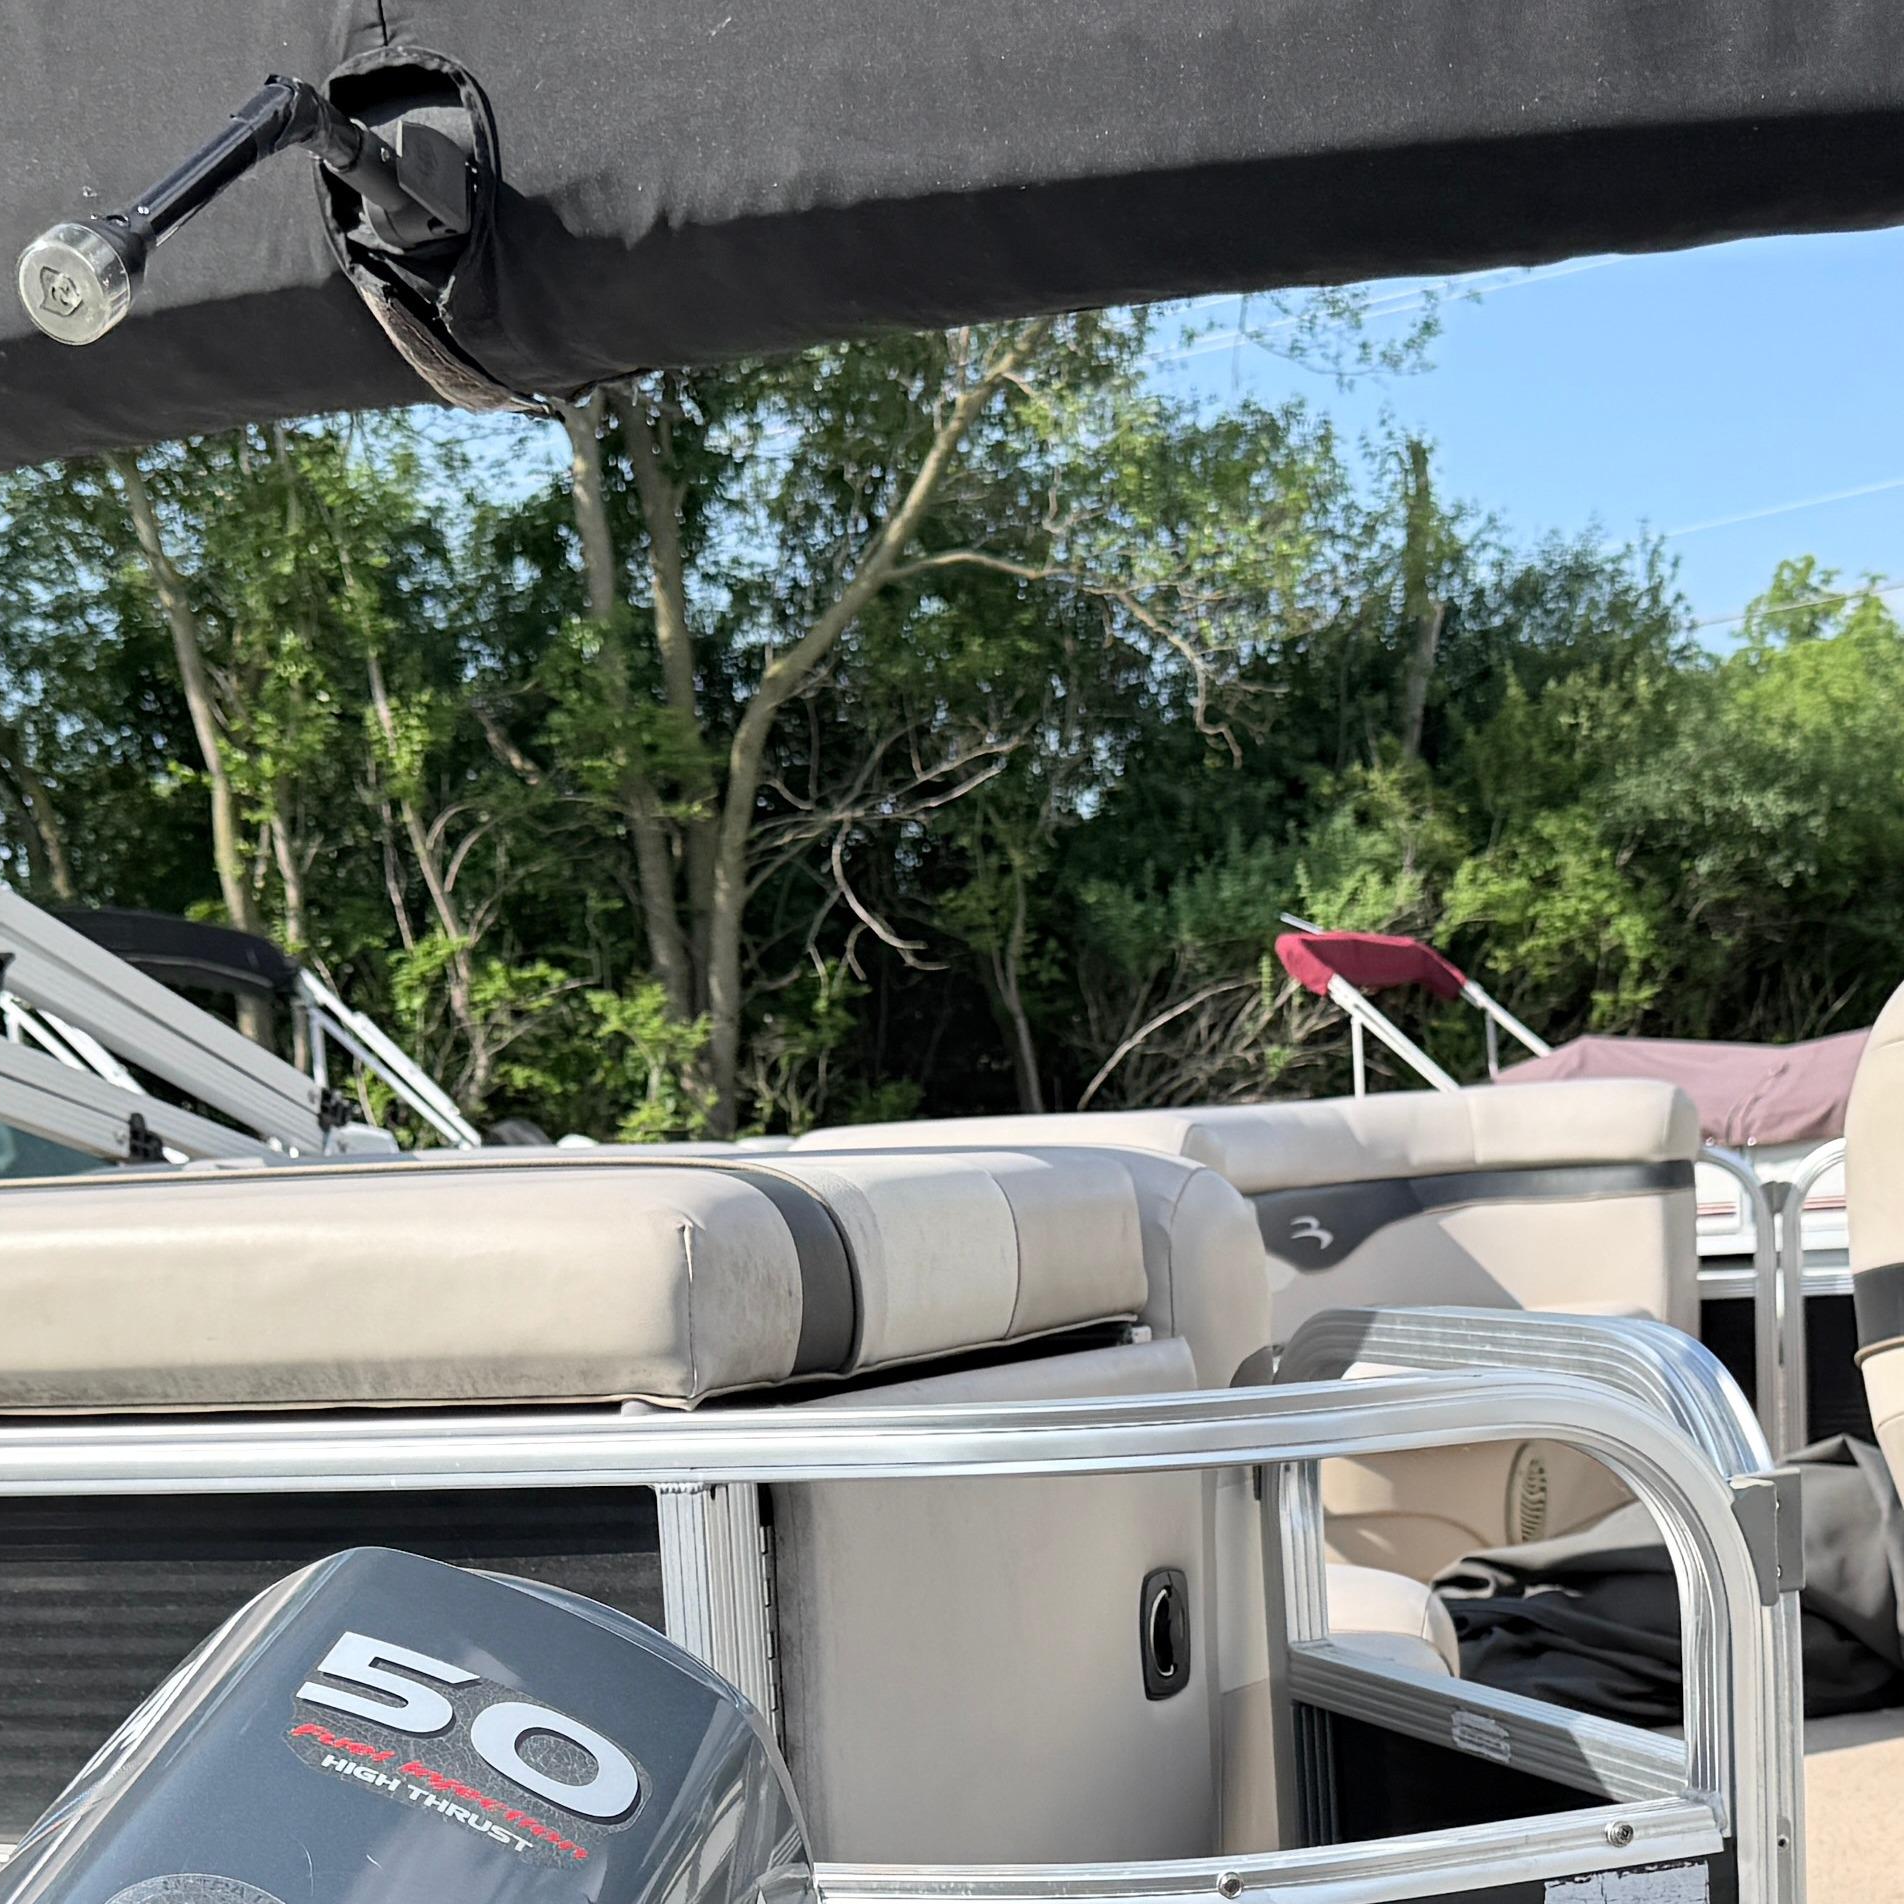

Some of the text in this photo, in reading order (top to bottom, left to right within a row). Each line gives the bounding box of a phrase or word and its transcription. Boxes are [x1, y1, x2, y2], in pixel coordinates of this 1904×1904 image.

[295, 1630, 642, 1821] 50
[320, 1753, 534, 1853] HIGH THRUST
